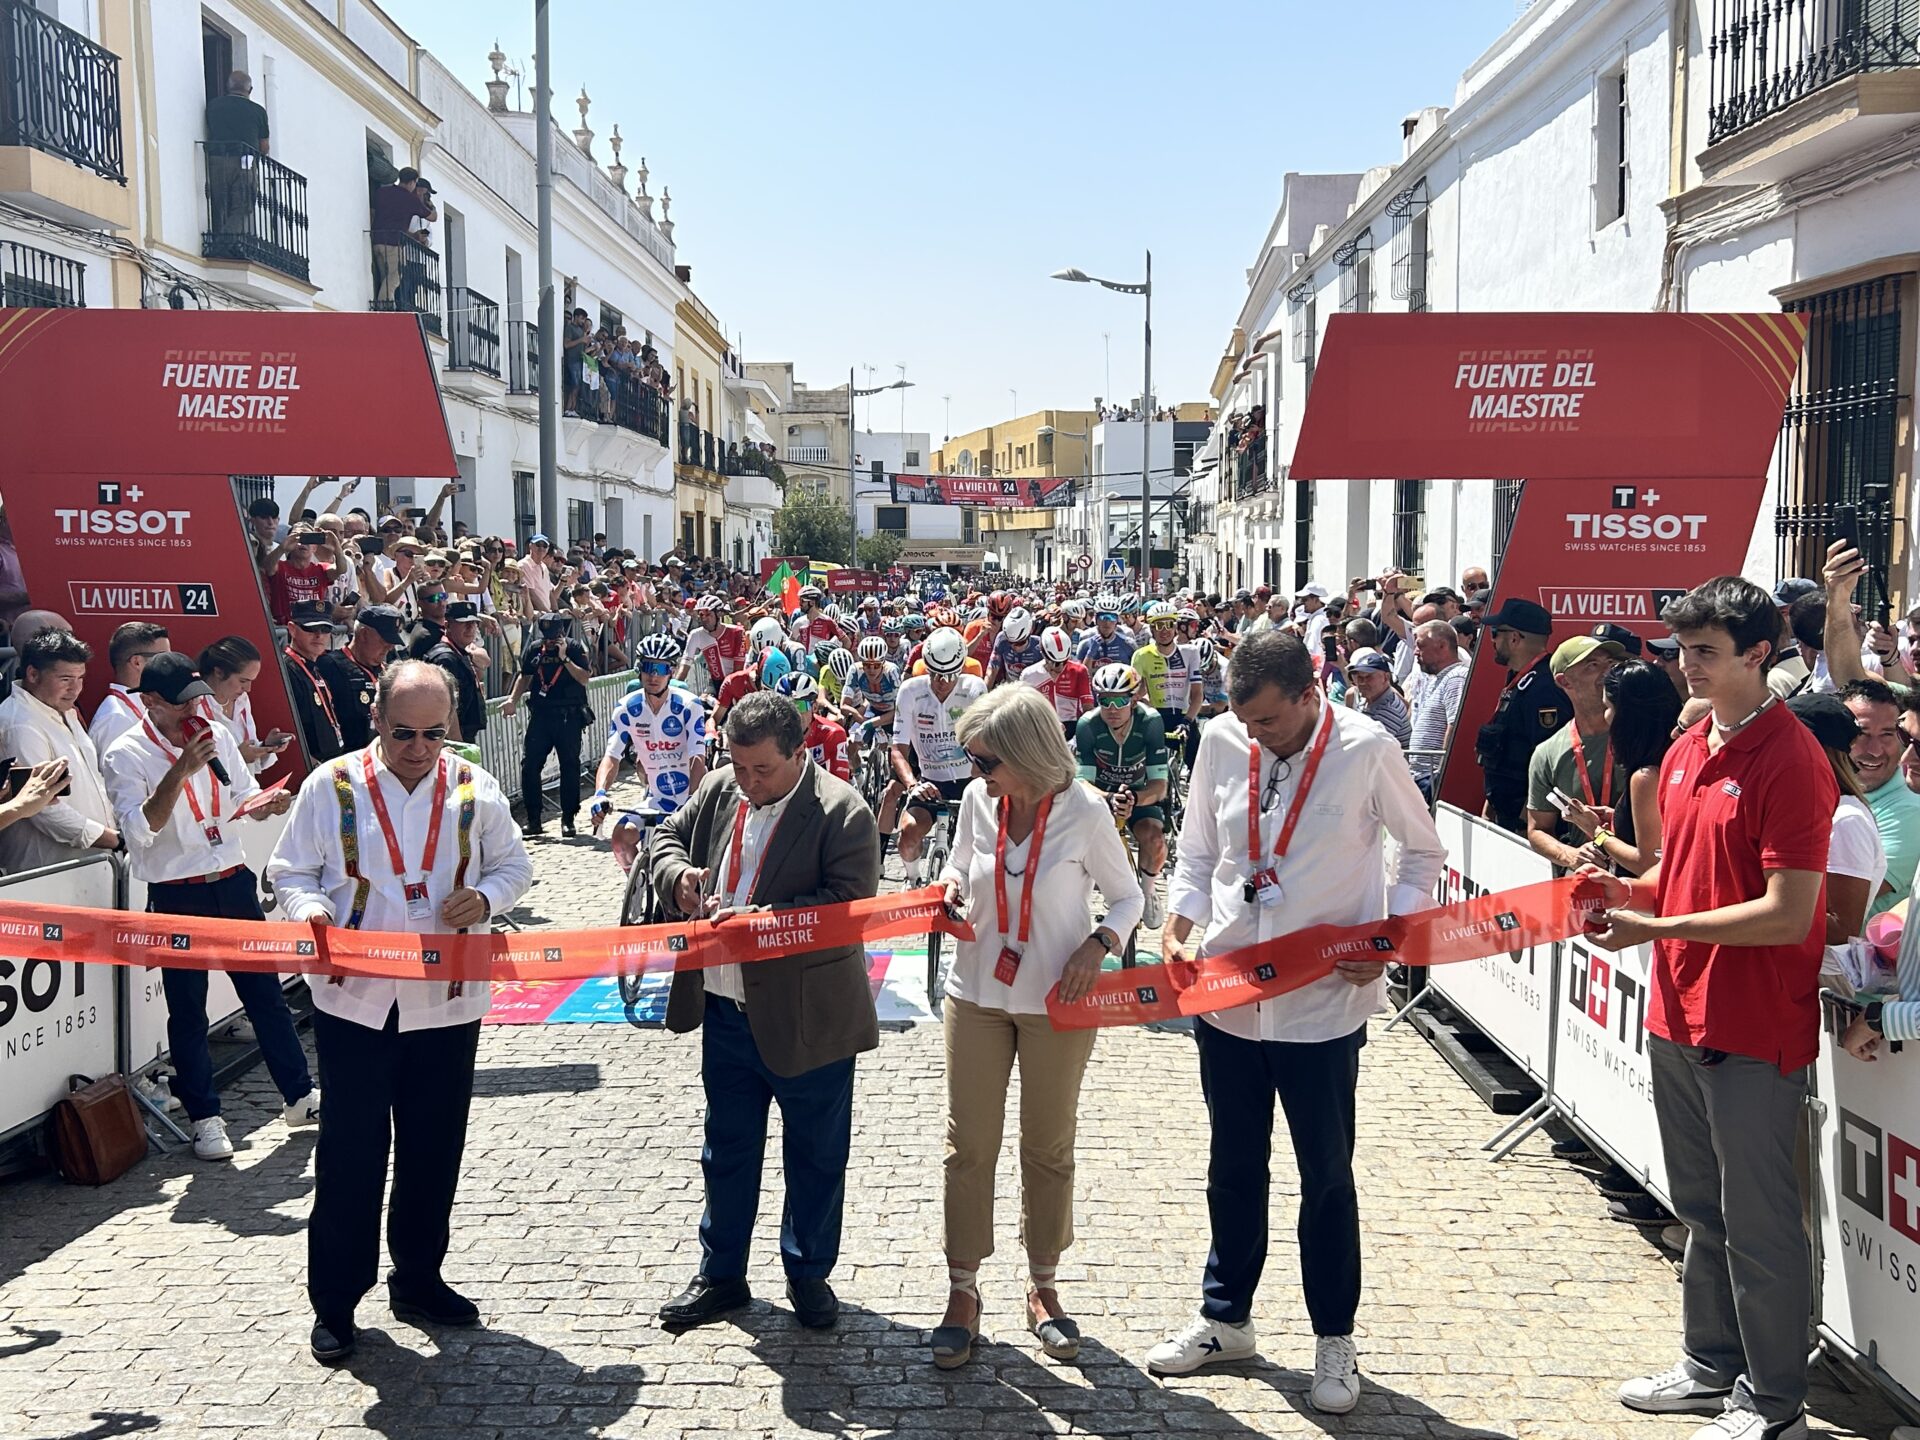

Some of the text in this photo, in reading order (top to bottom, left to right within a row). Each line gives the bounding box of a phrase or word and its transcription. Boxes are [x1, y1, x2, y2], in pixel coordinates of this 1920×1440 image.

[162, 363, 301, 390] FUENTE DEL
[1454, 362, 1597, 389] FUENTE DEL
[177, 394, 289, 420] MAESTRE
[1469, 393, 1585, 419] MAESTRE
[1003, 482, 1015, 493] 24
[54, 509, 191, 535] TISSOT
[1566, 513, 1708, 540] TISSOT
[55, 537, 192, 548] SWISS WATCHES SINCE 1853
[1564, 542, 1706, 553] SWISS WATCHES SINCE 1853
[81, 587, 209, 610] LA VUELTA 24
[1551, 593, 1573, 614] LA
[1576, 594, 1646, 616] VUELTA
[919, 731, 957, 739] BAHRA
[888, 911, 902, 921] LA
[902, 905, 942, 918] VUELTA
[1581, 898, 1606, 910] VUEL
[0, 922, 60, 938] VUELTA 24
[749, 911, 821, 932] FUENTE DEL
[1443, 915, 1515, 942] LA VUELTA 24
[117, 932, 188, 948] LA VUELTA 24
[242, 940, 312, 953] LA VUELTA 24
[613, 937, 684, 956] LA VUELTA 24
[757, 928, 815, 949] MAESTRE
[1321, 938, 1390, 959] LA VUELTA 24
[367, 948, 437, 962] LA VUELTA 24
[491, 950, 559, 962] LA VUELTA 24
[1207, 965, 1273, 992] LA VUELTA 24
[1491, 961, 1516, 994] SINCE
[1519, 981, 1541, 1011] 1853
[1086, 989, 1154, 1007] LA VUELTA 24
[55, 1006, 97, 1038] 1853
[1566, 1018, 1598, 1059] SWISS
[1840, 1219, 1918, 1293] SWISS
